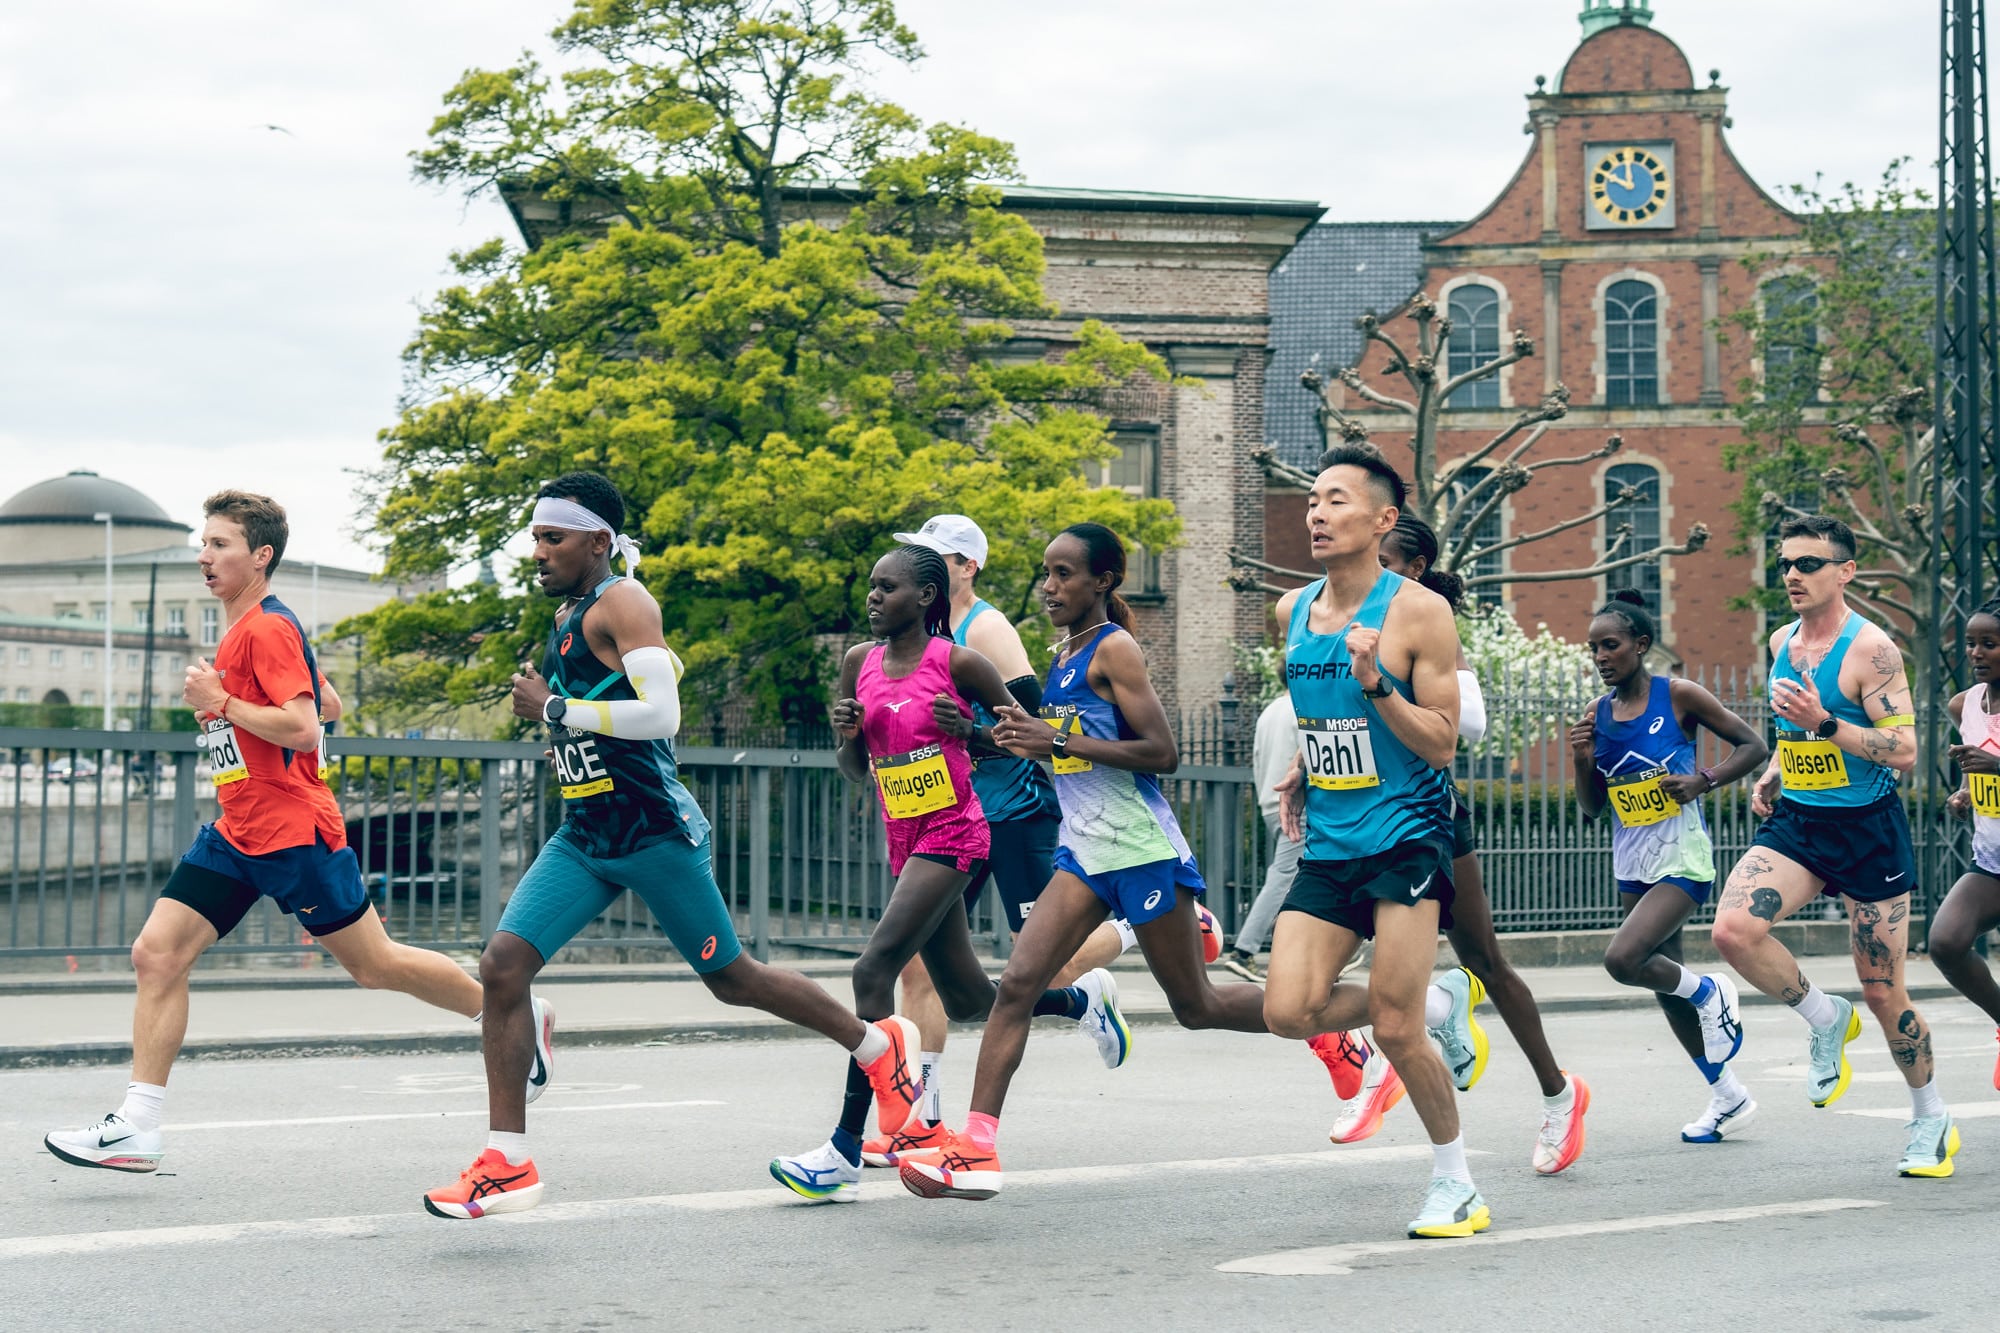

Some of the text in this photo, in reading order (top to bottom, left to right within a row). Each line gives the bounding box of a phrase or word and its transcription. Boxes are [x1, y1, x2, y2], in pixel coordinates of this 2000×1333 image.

[1326, 718, 1357, 731] M190
[553, 739, 608, 783] ACE
[908, 746, 932, 763] F55
[1306, 733, 1364, 776] Dahl
[1783, 747, 1840, 775] Olesen
[881, 768, 945, 801] Kiptugen
[1640, 769, 1659, 781] F57
[1974, 775, 1999, 807] Uri
